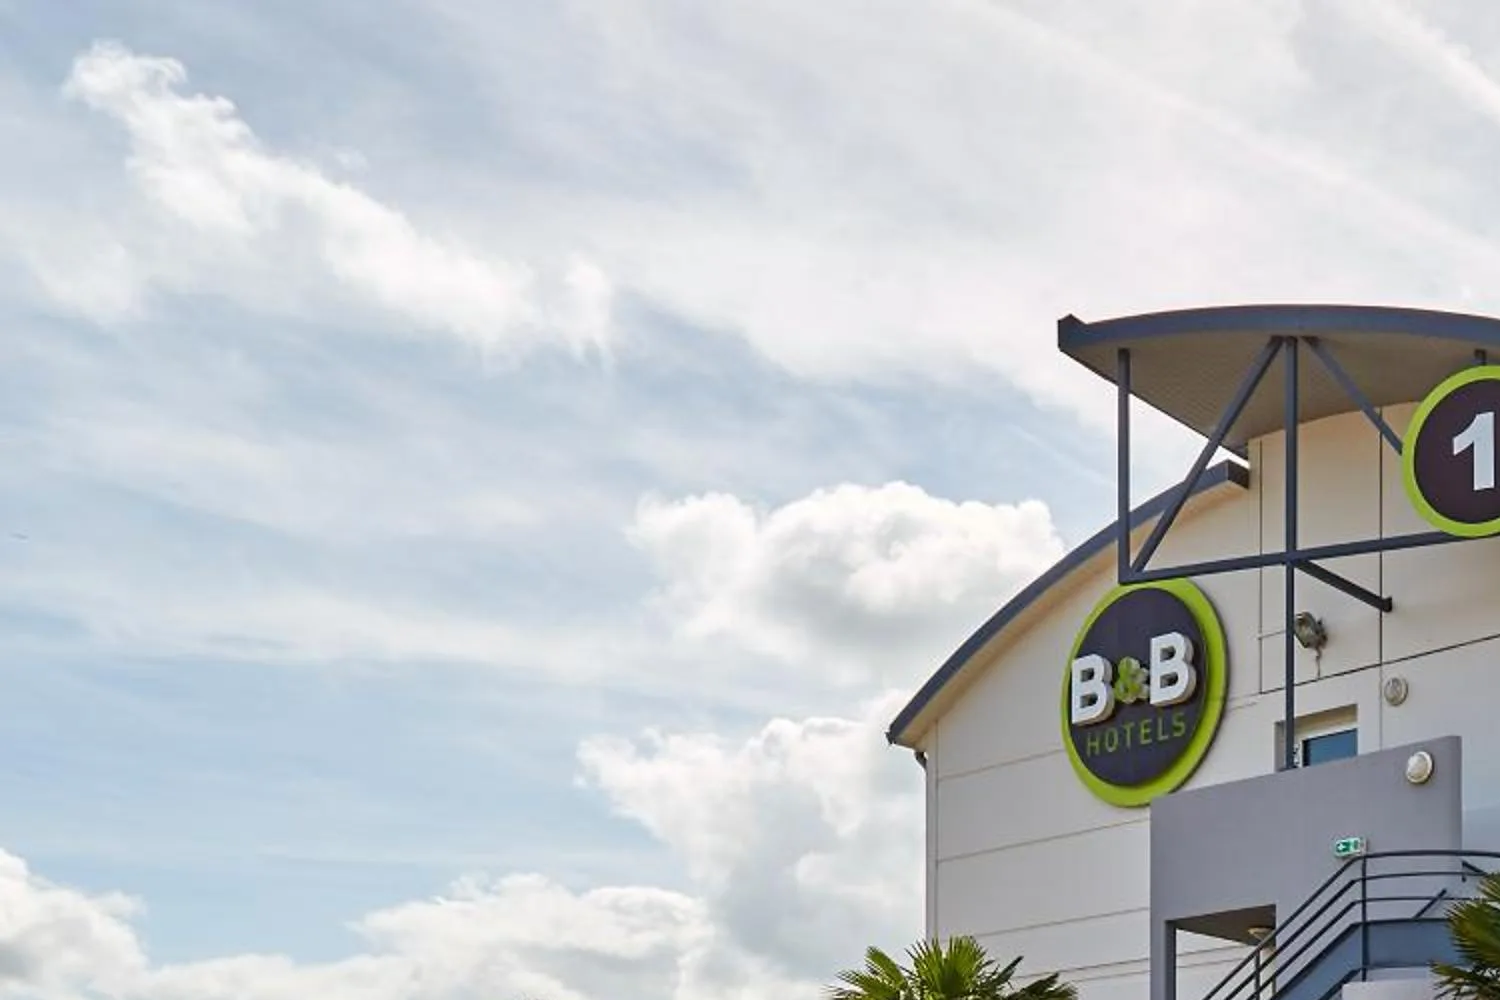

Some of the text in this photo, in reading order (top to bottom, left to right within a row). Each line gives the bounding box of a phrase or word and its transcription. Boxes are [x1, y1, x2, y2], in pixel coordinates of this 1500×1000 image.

[1453, 411, 1494, 491] 1
[1072, 631, 1197, 726] B&B
[1086, 711, 1187, 758] HOTELS
